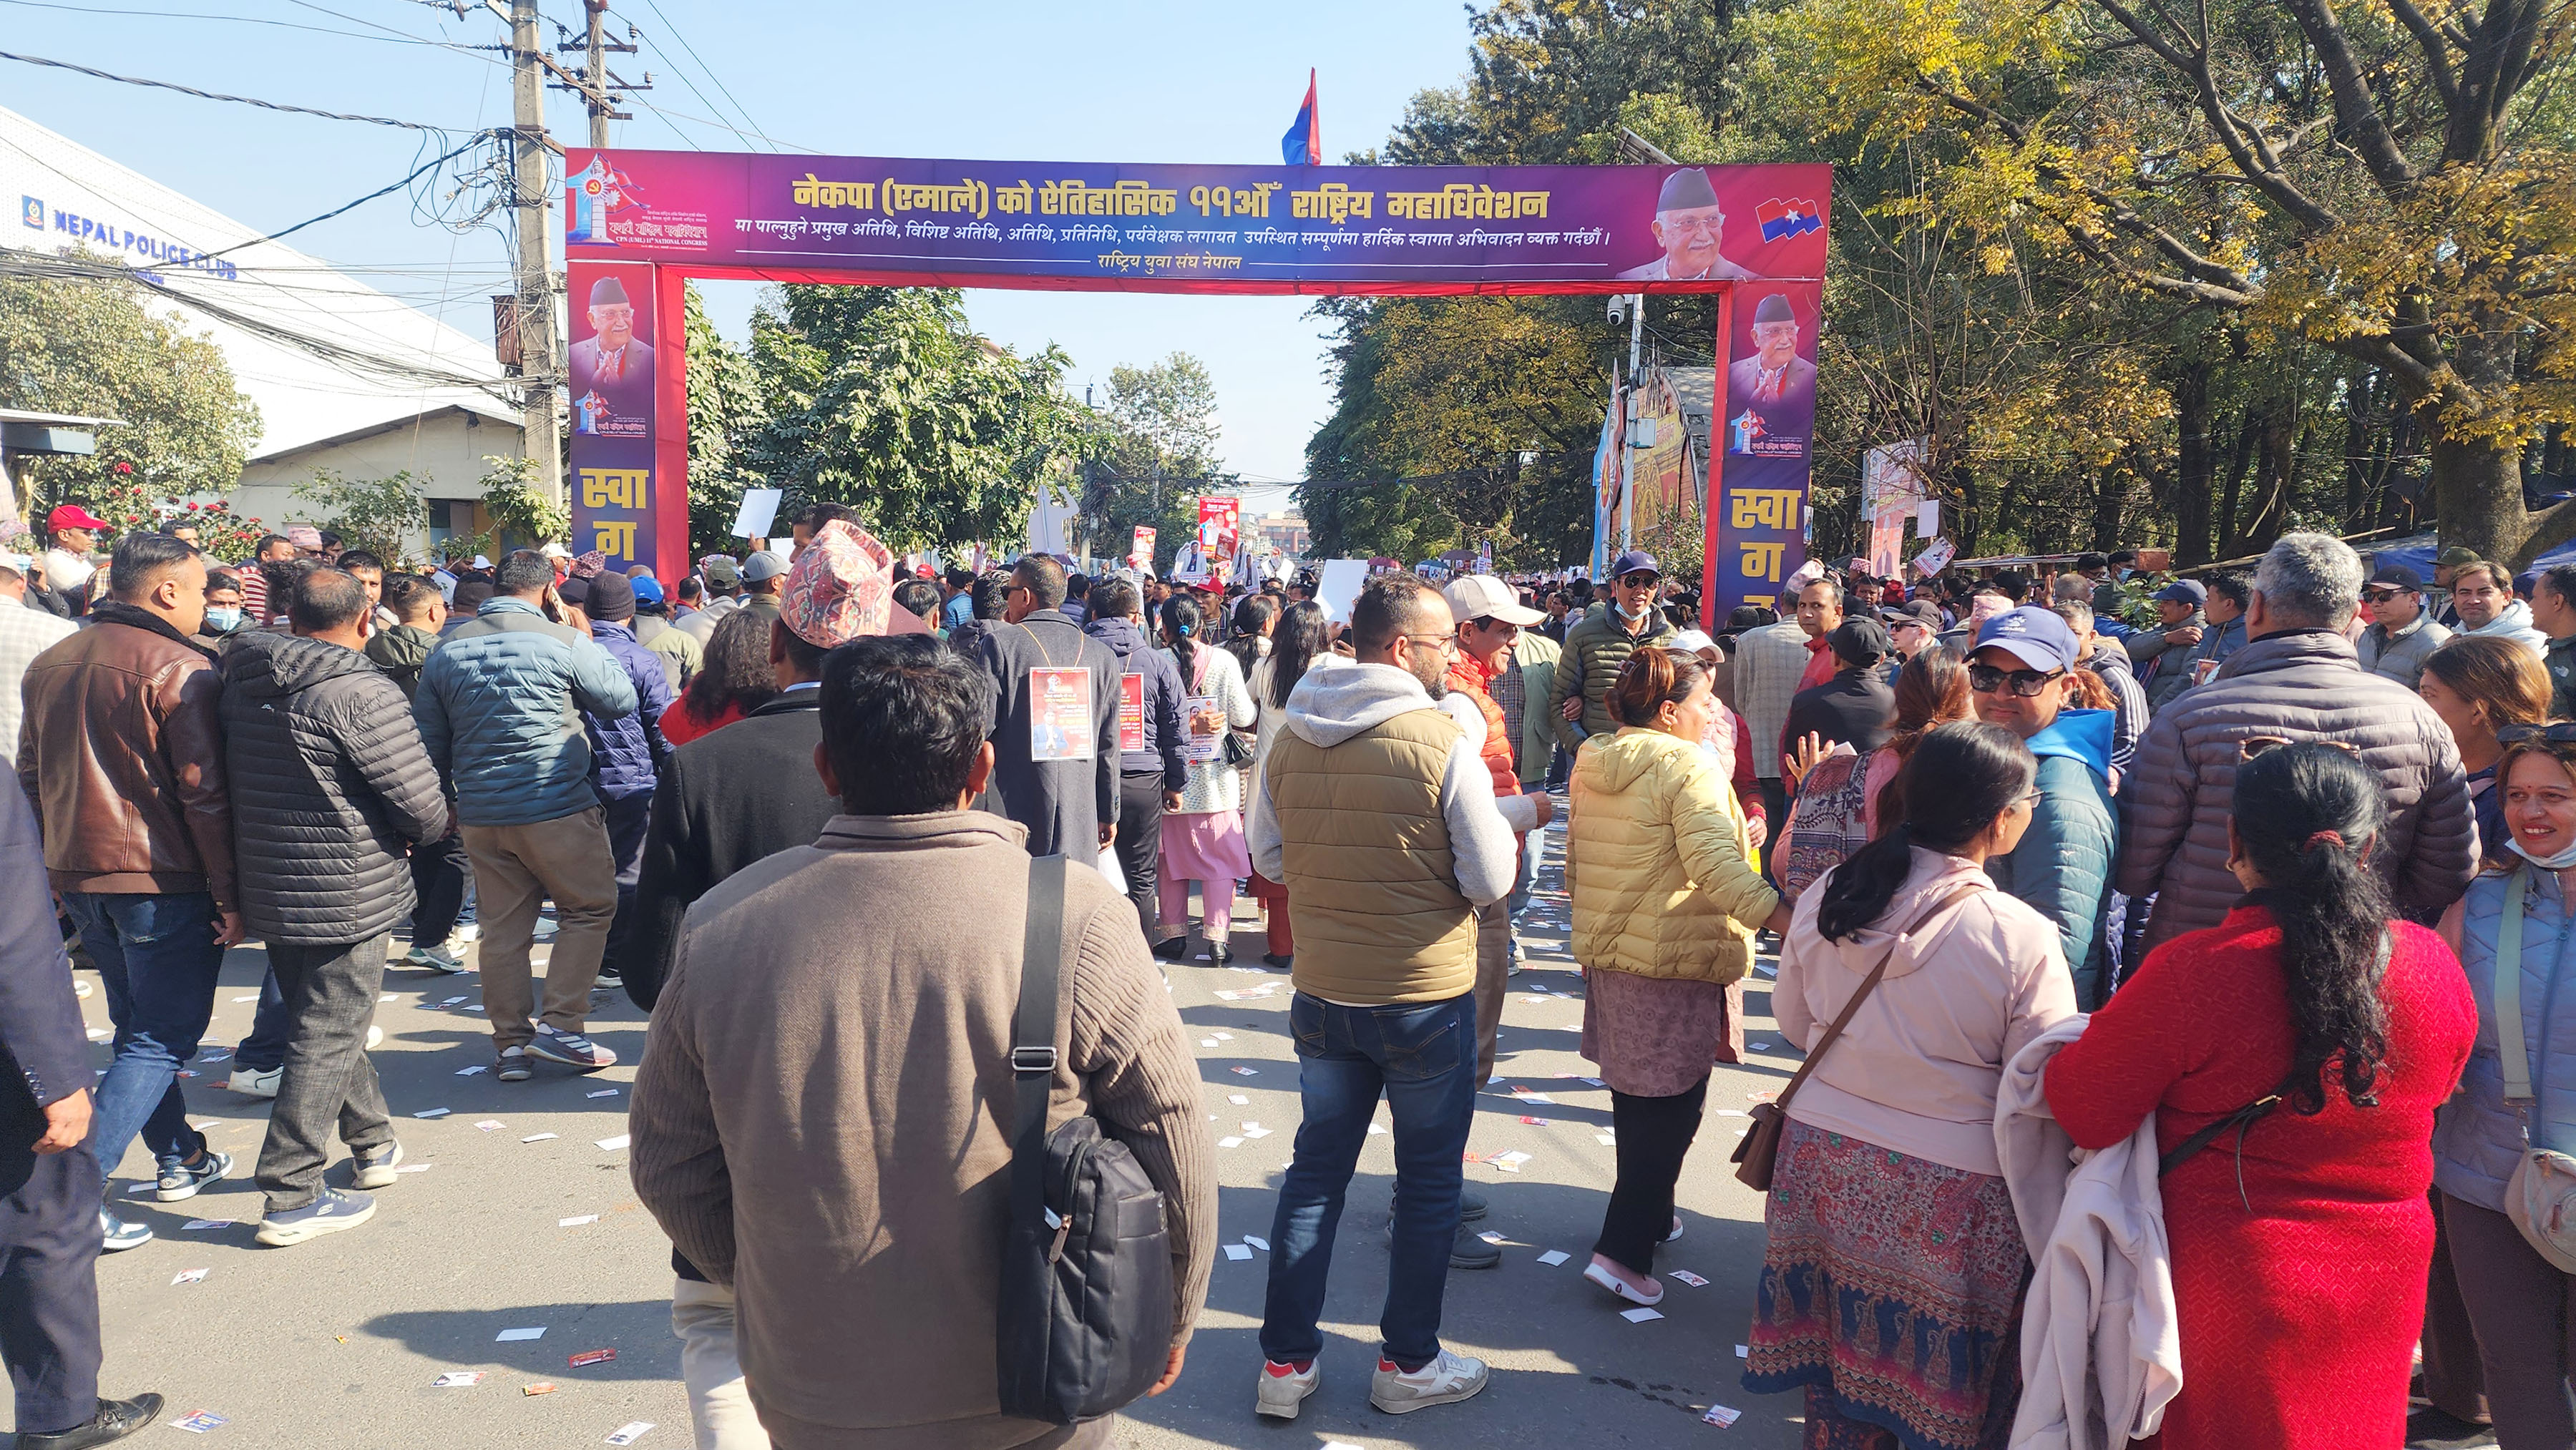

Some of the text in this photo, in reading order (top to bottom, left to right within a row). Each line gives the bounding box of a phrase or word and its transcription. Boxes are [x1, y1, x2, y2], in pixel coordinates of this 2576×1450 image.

[792, 173, 874, 210] नेकपा
[882, 178, 989, 218] (एमाले)
[995, 180, 1033, 214] को
[1039, 180, 1176, 215] ऐतिहासिक
[1291, 183, 1374, 224] राष्ट्रिय
[1386, 184, 1550, 220] महाधिवेशन
[54, 210, 120, 247] NEPAL
[124, 230, 190, 267] POLICE
[194, 253, 237, 280] CLUB
[735, 218, 752, 232] मा
[755, 216, 808, 240] पाल्नुहुने
[810, 222, 848, 241] प्रमुख
[851, 218, 901, 240] अतिथि,
[904, 220, 950, 240] विशिष्ट
[953, 221, 1003, 243] अतिथि,
[1007, 222, 1057, 244] अतिथि,
[1060, 224, 1121, 245] प्रतिनिधि,
[1125, 225, 1184, 244] पर्यवेक्षक
[1187, 230, 1237, 245] लगायत
[1244, 226, 1299, 245] उपस्थित
[1301, 227, 1360, 251] सम्पूर्णमा
[1362, 227, 1406, 247] हार्दिक
[1408, 232, 1454, 247] स्वागत
[1456, 227, 1524, 248] अभिवादन
[1526, 232, 1561, 246] व्यक्त
[1097, 250, 1242, 275] राष्ट्रिय युवा संघ नेपाल
